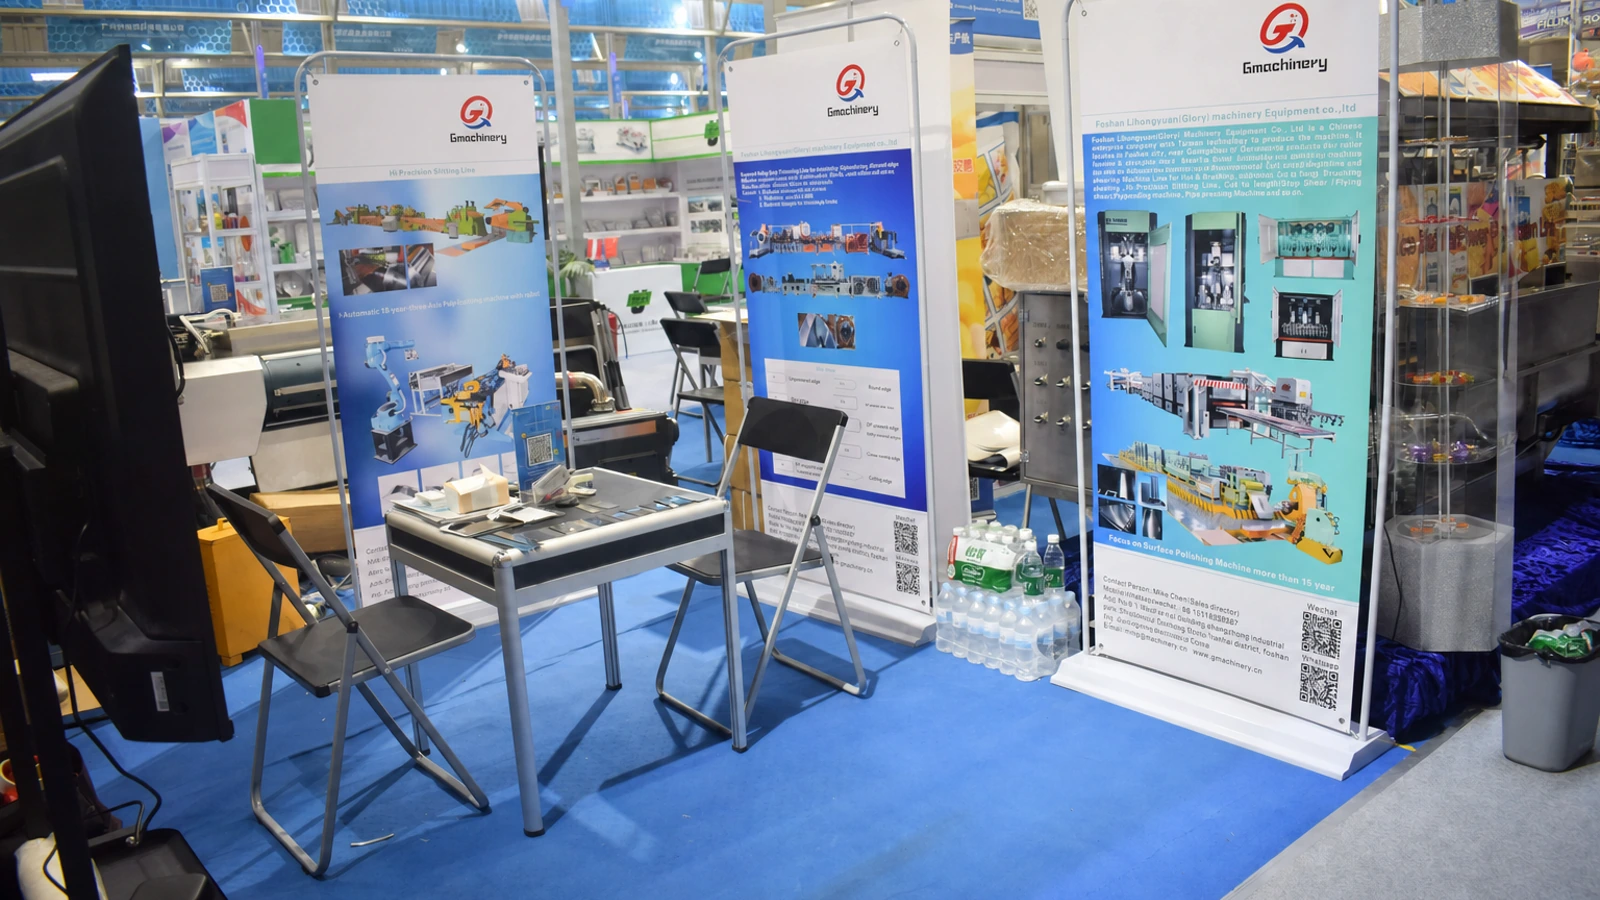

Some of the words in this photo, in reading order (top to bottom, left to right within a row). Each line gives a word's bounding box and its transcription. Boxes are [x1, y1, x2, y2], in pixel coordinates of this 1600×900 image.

[1243, 58, 1328, 74] Gmachinery
[827, 105, 879, 117] Gmachinery
[1095, 120, 1125, 129] Foshan
[1211, 110, 1262, 122] machinery
[1264, 106, 1320, 119] Equipment
[1322, 103, 1357, 114] co.,ltd
[1290, 125, 1304, 133] Ltd
[1328, 122, 1363, 131] Chinese
[450, 132, 507, 145] Gmachinery
[1108, 534, 1131, 546] Focus
[1131, 540, 1142, 548] on
[1142, 541, 1174, 556] Surface
[1175, 548, 1214, 566] Polishing
[1215, 557, 1252, 574] Machine
[1253, 568, 1277, 579] more
[1278, 573, 1299, 585] than
[1301, 578, 1313, 587] 15
[1314, 582, 1336, 592] year
[1306, 602, 1338, 617] Wechat
[1262, 648, 1290, 662] foshan
